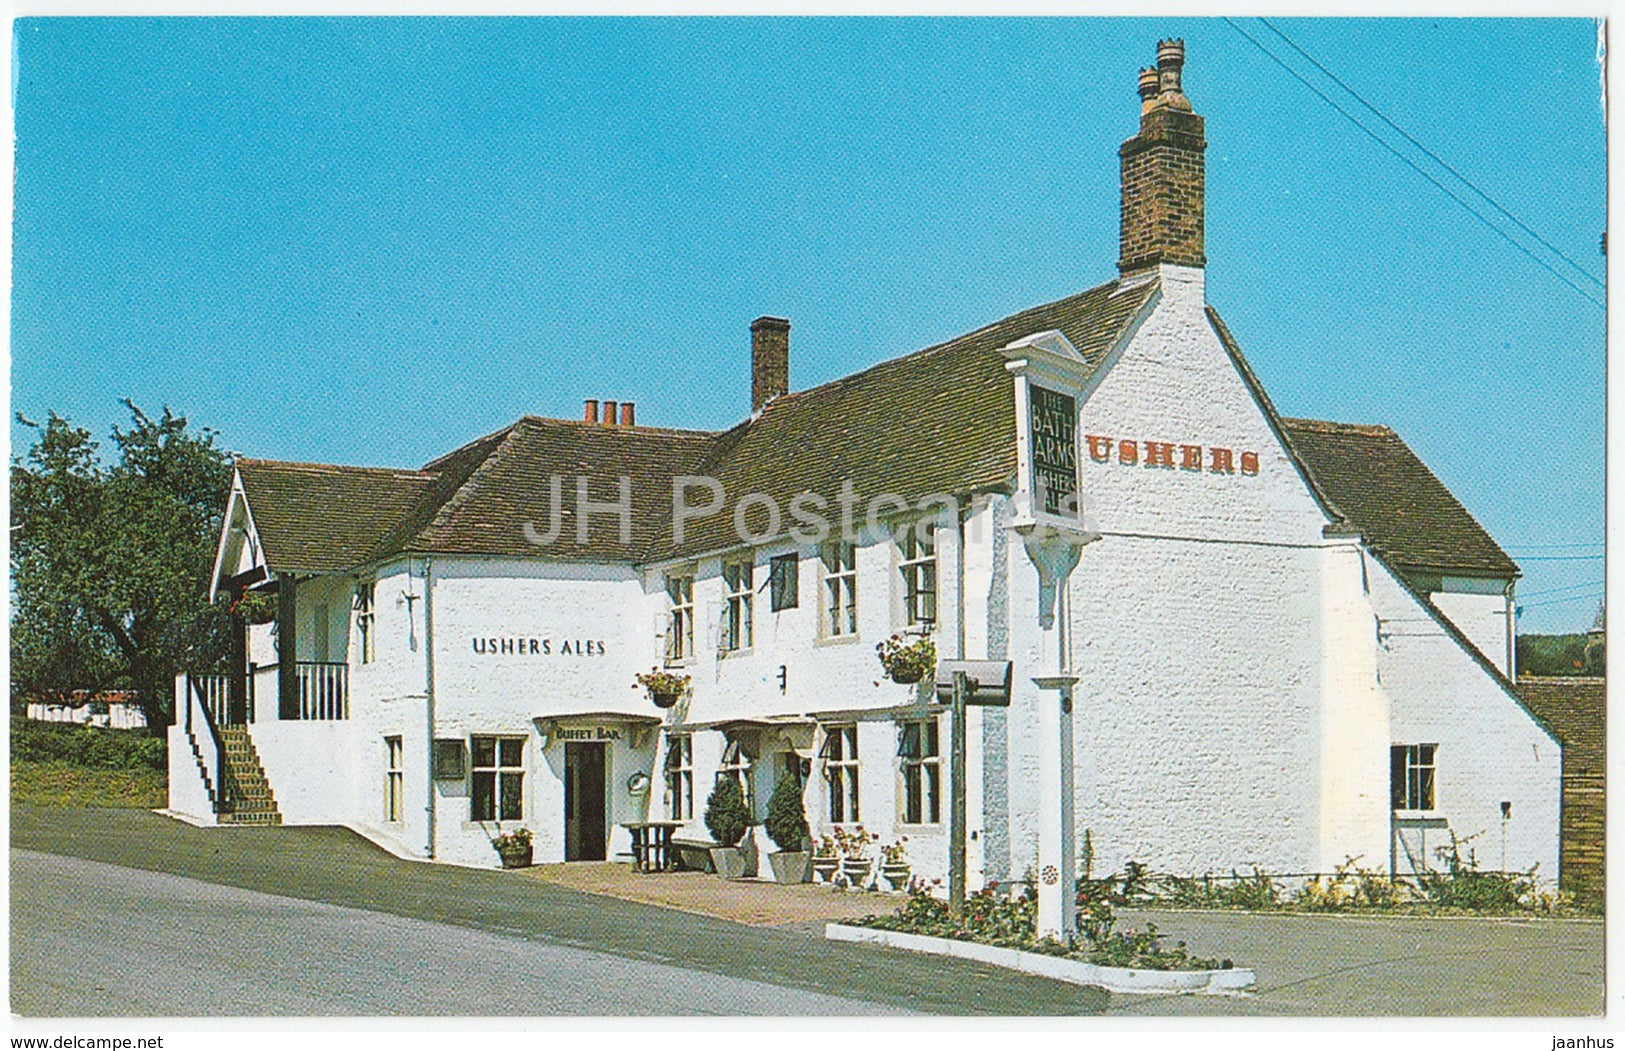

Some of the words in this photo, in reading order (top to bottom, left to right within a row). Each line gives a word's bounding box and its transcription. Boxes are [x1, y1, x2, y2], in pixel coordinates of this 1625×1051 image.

[1041, 391, 1062, 409] THE
[1032, 404, 1073, 441] BATH
[1034, 436, 1075, 469] ARMS
[1085, 435, 1260, 477] USHERS
[472, 637, 551, 655] USHERS
[560, 639, 606, 656] ALES
[556, 727, 593, 740] BUFFET
[597, 726, 621, 740] BAR
